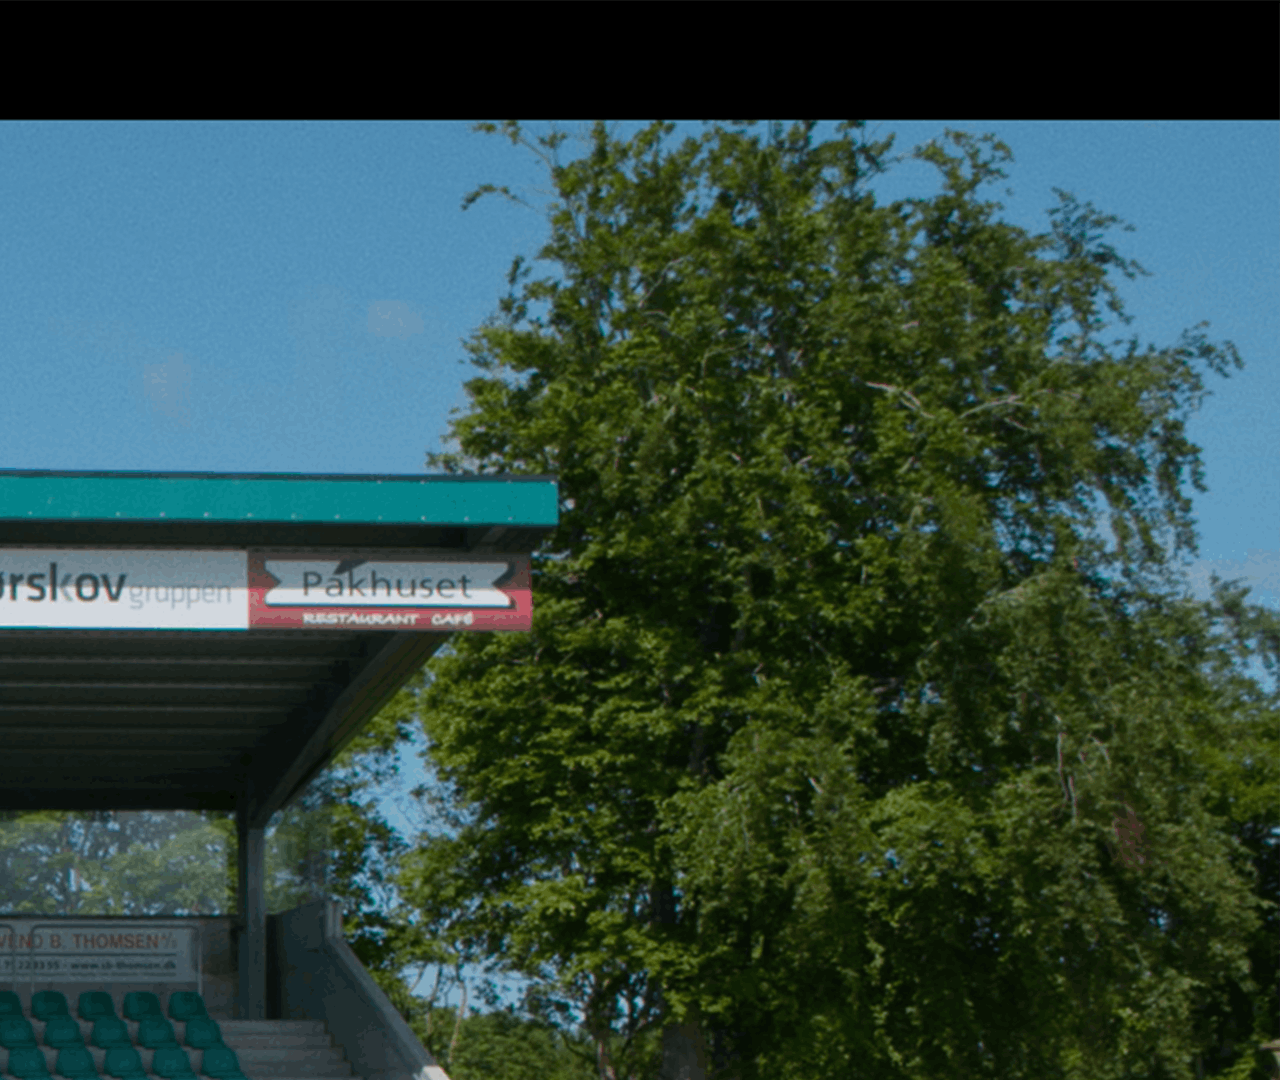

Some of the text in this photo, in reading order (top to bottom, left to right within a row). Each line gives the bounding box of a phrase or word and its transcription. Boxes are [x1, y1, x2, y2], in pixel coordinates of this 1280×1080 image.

[128, 579, 231, 610] gruppen
[303, 569, 472, 599] Pakhuset
[302, 610, 474, 627] RESTAURANT CAFÉ
[71, 933, 159, 950] THOMSEN
